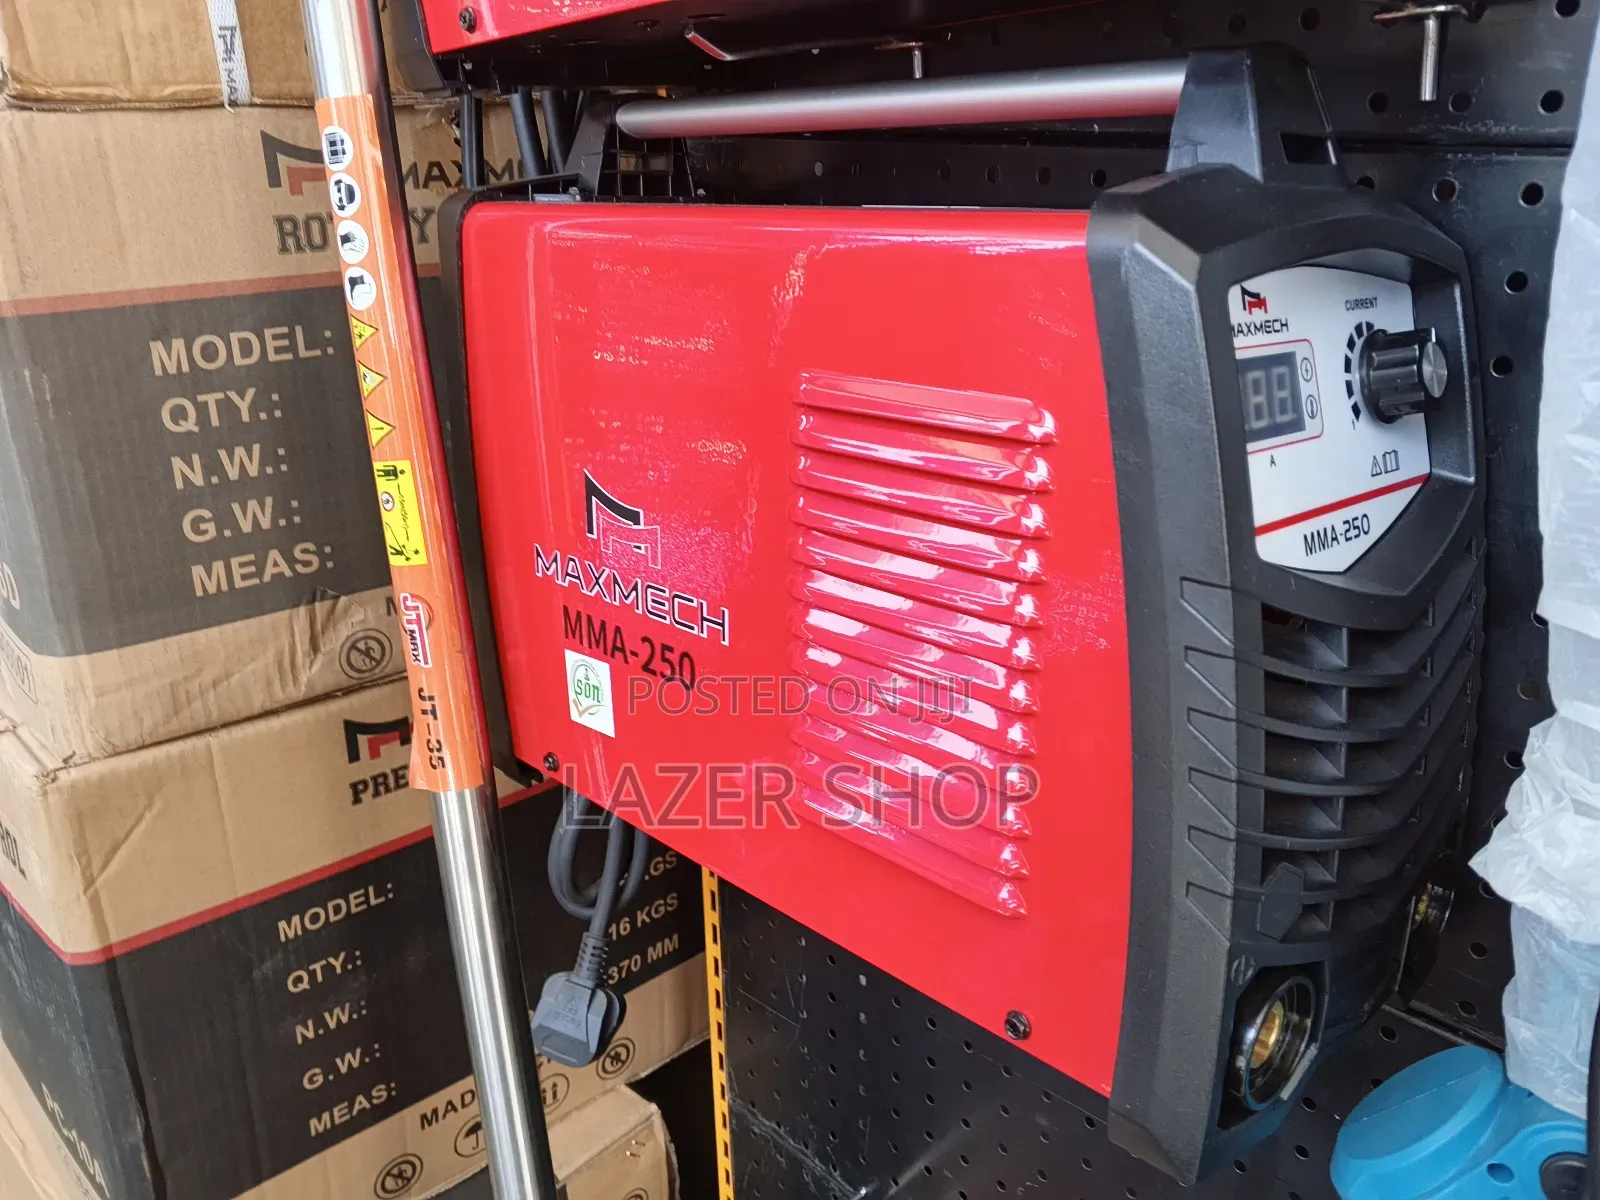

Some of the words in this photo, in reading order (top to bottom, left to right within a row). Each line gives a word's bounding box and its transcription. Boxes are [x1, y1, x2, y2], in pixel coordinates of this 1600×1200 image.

[1344, 297, 1379, 312] CURRENT
[149, 325, 335, 377] MODEL:
[160, 387, 283, 434] QTY.:
[170, 443, 288, 490] N.W.:
[1269, 454, 1277, 468] A
[182, 496, 302, 543] G.W.:
[1303, 512, 1371, 557] MMA-250
[190, 541, 335, 598] MEAS:
[533, 542, 730, 647] MAXMECH
[562, 604, 696, 692] MMA-250
[417, 687, 446, 770] JT-35
[277, 882, 394, 943] MODEL:
[607, 916, 632, 942] 16
[636, 892, 679, 929] KGS
[286, 949, 363, 994] QTY.:
[606, 954, 642, 986] 370
[647, 932, 680, 965] MM
[295, 1000, 368, 1045] N.W.:
[302, 1043, 381, 1091] G.W.:
[308, 1081, 397, 1138] MEAS:
